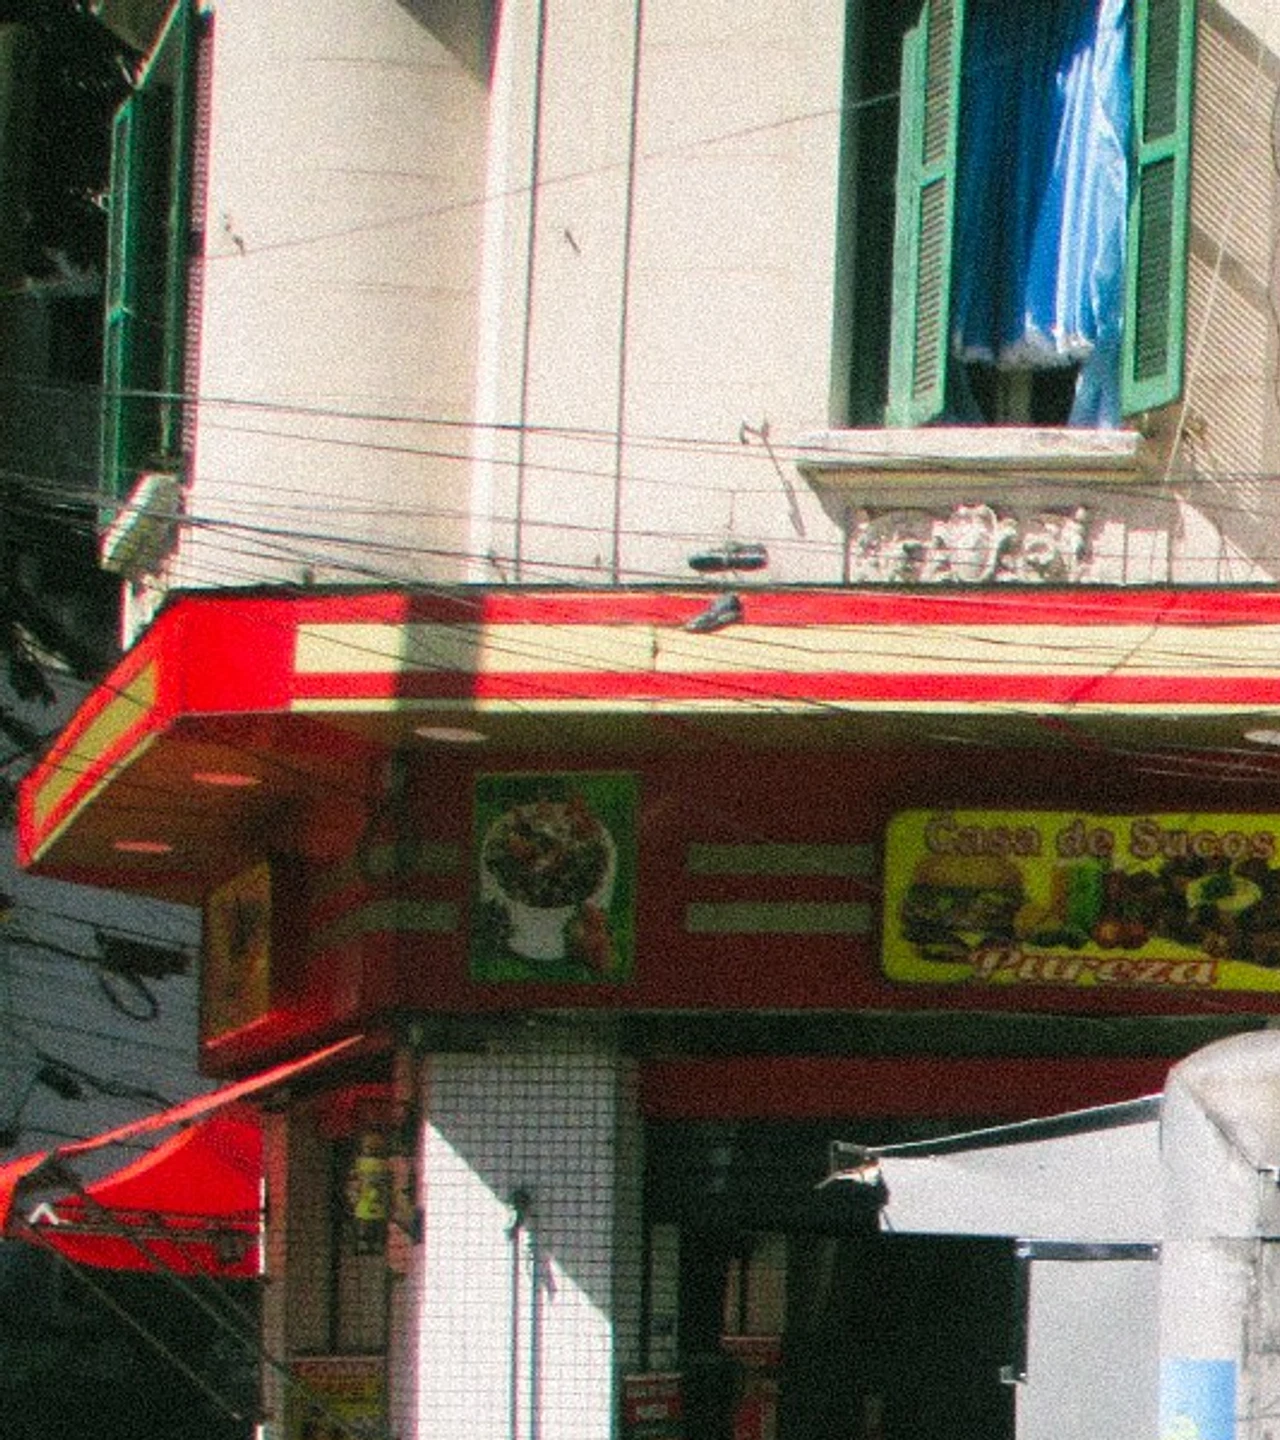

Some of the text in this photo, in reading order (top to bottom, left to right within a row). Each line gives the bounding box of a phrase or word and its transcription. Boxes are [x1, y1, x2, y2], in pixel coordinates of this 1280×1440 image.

[924, 815, 1277, 861] Casa de Sucos
[970, 946, 1219, 986] Pureza
